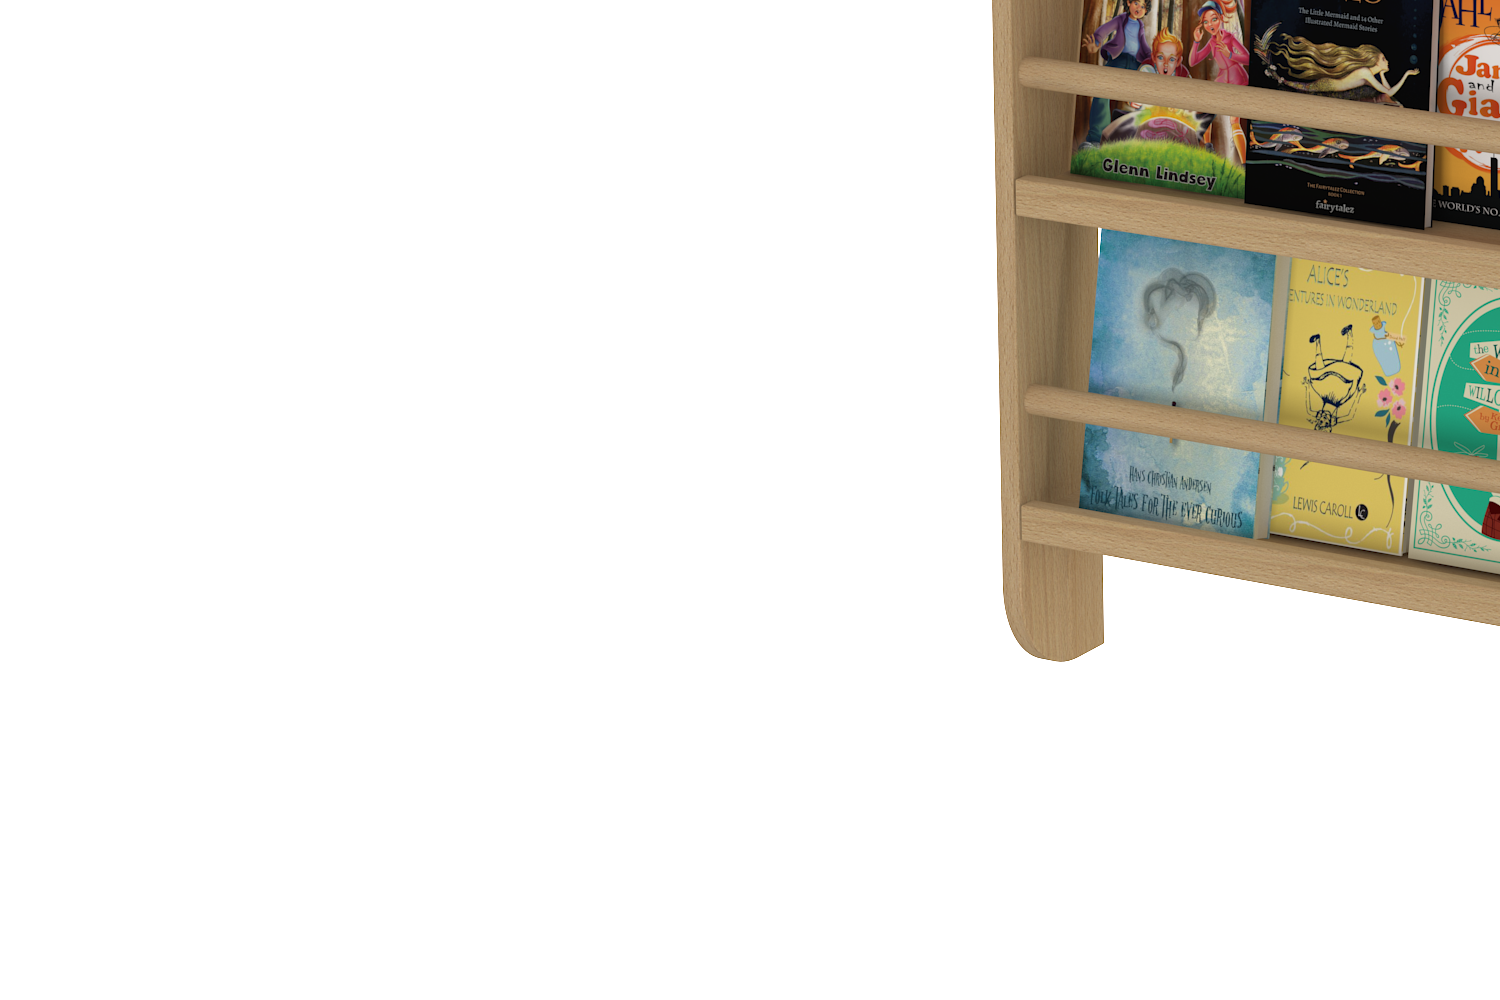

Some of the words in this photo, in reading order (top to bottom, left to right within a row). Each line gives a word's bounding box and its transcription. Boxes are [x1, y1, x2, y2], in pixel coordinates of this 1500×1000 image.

[1299, 7, 1309, 15] The
[1310, 9, 1324, 17] Little
[1325, 11, 1350, 20] Mermaid
[1368, 16, 1384, 25] Other
[1305, 17, 1333, 27] Illustrated
[1333, 21, 1359, 31] Mermaid
[1359, 24, 1378, 33] Stories
[1468, 80, 1495, 93] and
[1102, 158, 1150, 179] Glenn
[1156, 166, 1217, 192] Lindsey
[1315, 200, 1355, 214] fairytalez
[1438, 201, 1481, 214] WORLD'S
[1482, 207, 1500, 217] NO.
[1307, 264, 1349, 288] ALICE'S
[1325, 294, 1336, 308] IN
[1337, 296, 1398, 316] WONDERLAND
[1474, 344, 1489, 354] the
[1484, 360, 1499, 378] in
[1480, 412, 1490, 422] by
[1129, 466, 1146, 483] HANS
[1147, 471, 1178, 489] CHRISTIAN
[1180, 476, 1212, 495] ANDERSEN
[1114, 486, 1139, 510] TALES
[1142, 494, 1159, 517] FOR
[1161, 494, 1178, 521] THE
[1181, 501, 1202, 524] EVER
[1206, 505, 1243, 529] CURIOUS
[1293, 496, 1318, 513] LEWIS
[1320, 501, 1353, 519] CAROLL
